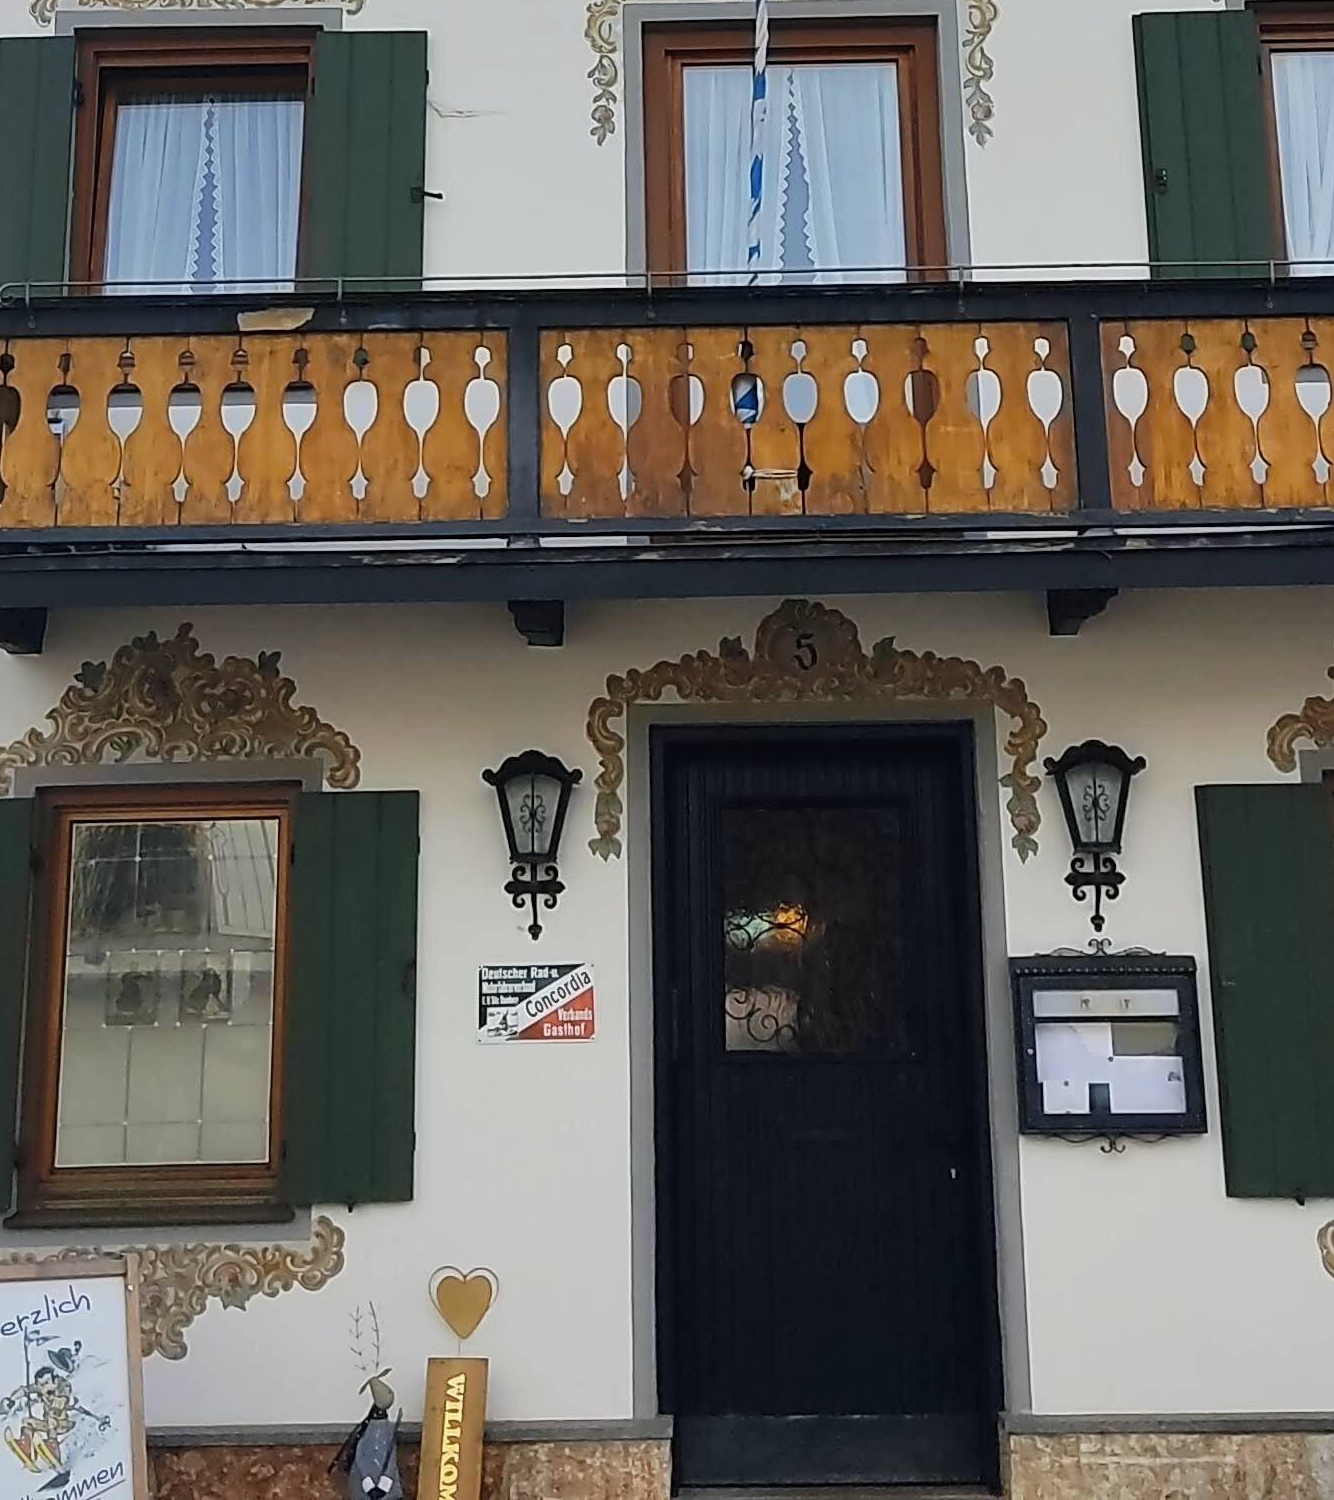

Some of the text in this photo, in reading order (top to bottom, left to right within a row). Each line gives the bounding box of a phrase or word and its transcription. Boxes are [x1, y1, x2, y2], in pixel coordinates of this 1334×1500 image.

[793, 633, 817, 670] 5
[481, 967, 527, 980] Deutscher
[525, 971, 592, 1017] Concordia
[543, 1022, 586, 1037] Gasthof
